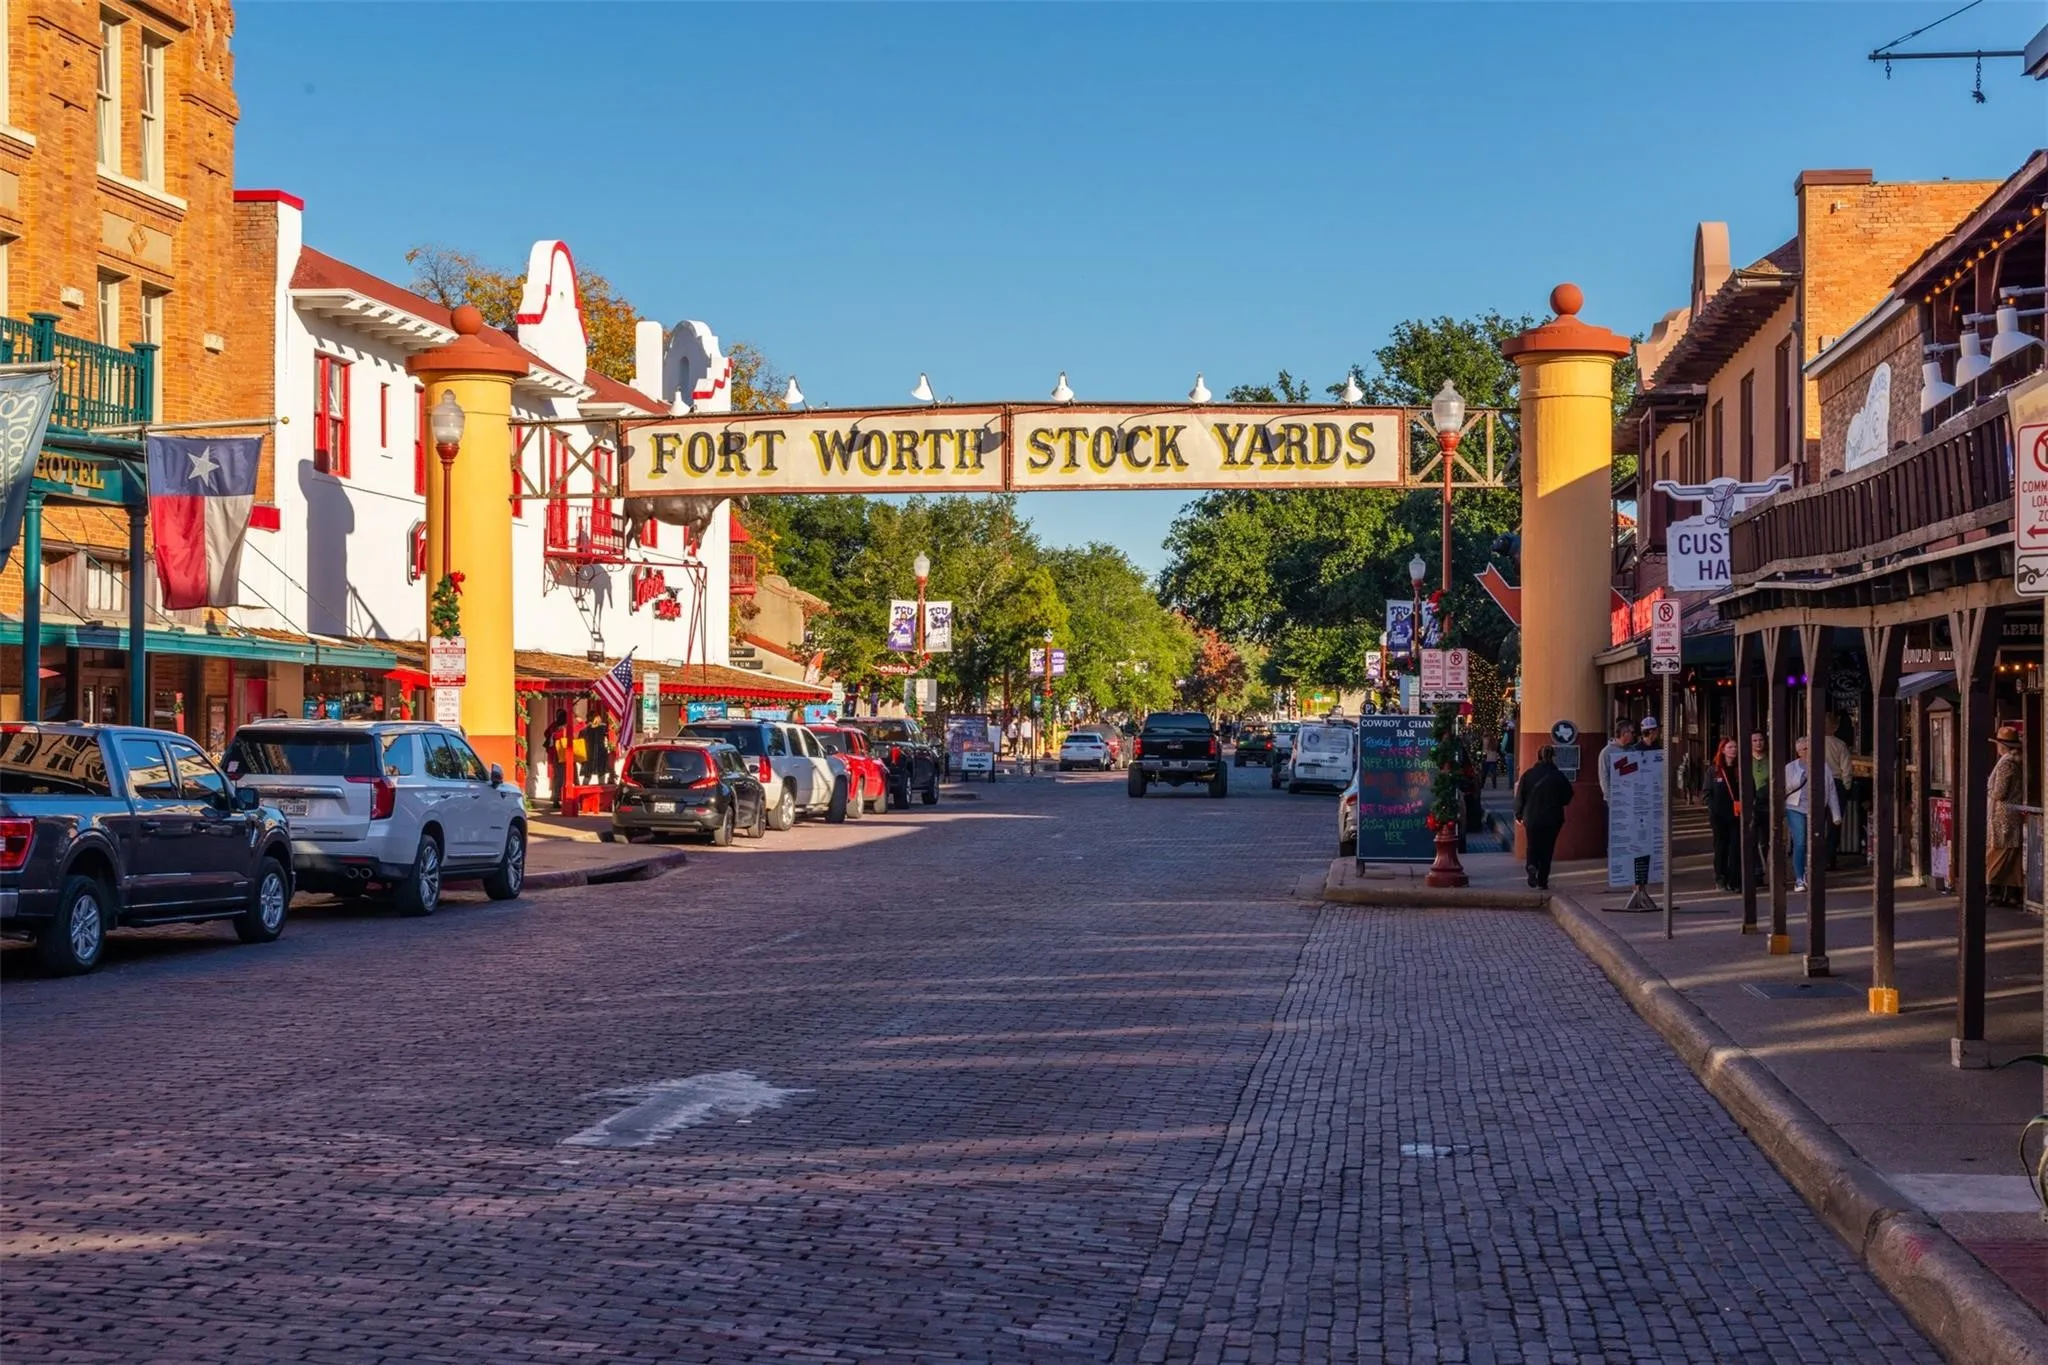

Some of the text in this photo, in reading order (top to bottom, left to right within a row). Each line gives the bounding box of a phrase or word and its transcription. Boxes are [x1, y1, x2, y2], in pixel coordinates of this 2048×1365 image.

[647, 422, 1377, 479] FORT WORTH STOCK YARDS
[1698, 559, 1730, 581] HA
[894, 606, 914, 615] TCU
[929, 606, 948, 616] TCU
[1390, 606, 1410, 615] TCU
[1361, 719, 1401, 728] COWBOY
[1396, 729, 1415, 737] BAR
